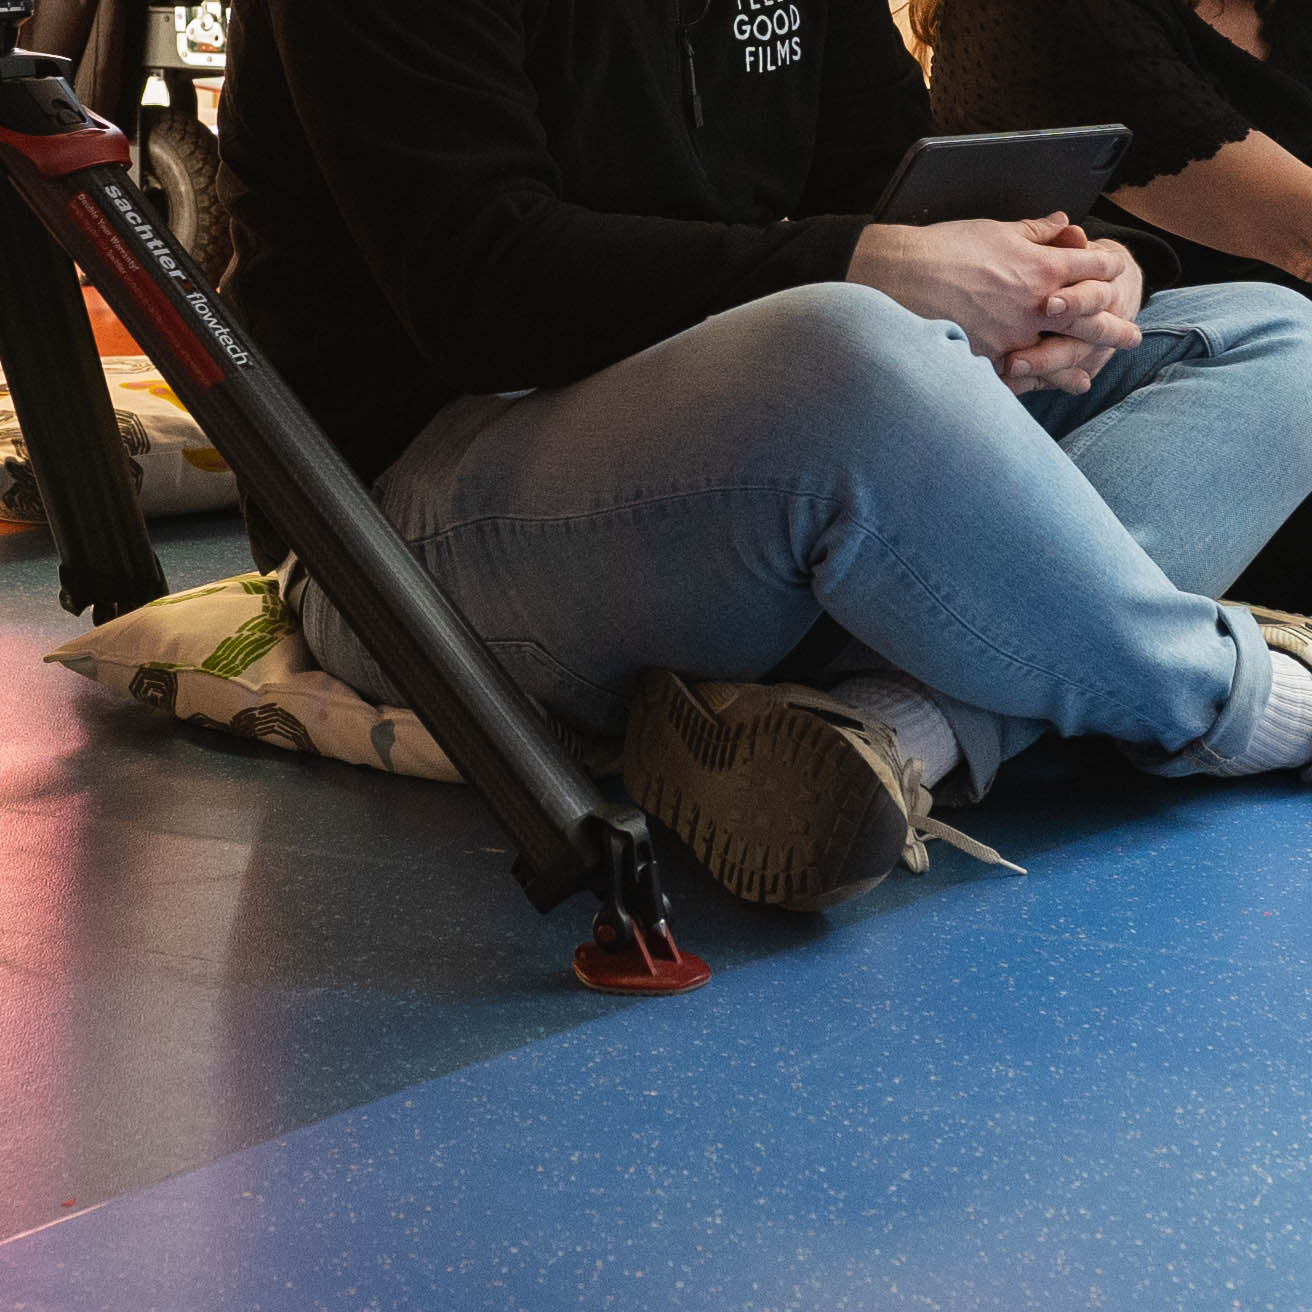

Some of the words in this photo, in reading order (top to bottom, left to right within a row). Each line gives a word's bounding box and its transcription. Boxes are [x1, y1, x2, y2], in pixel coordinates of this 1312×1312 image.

[733, 4, 801, 40] GOOD
[745, 36, 802, 73] FILMS
[104, 184, 186, 282] sachtler
[186, 291, 250, 366] flowtech
